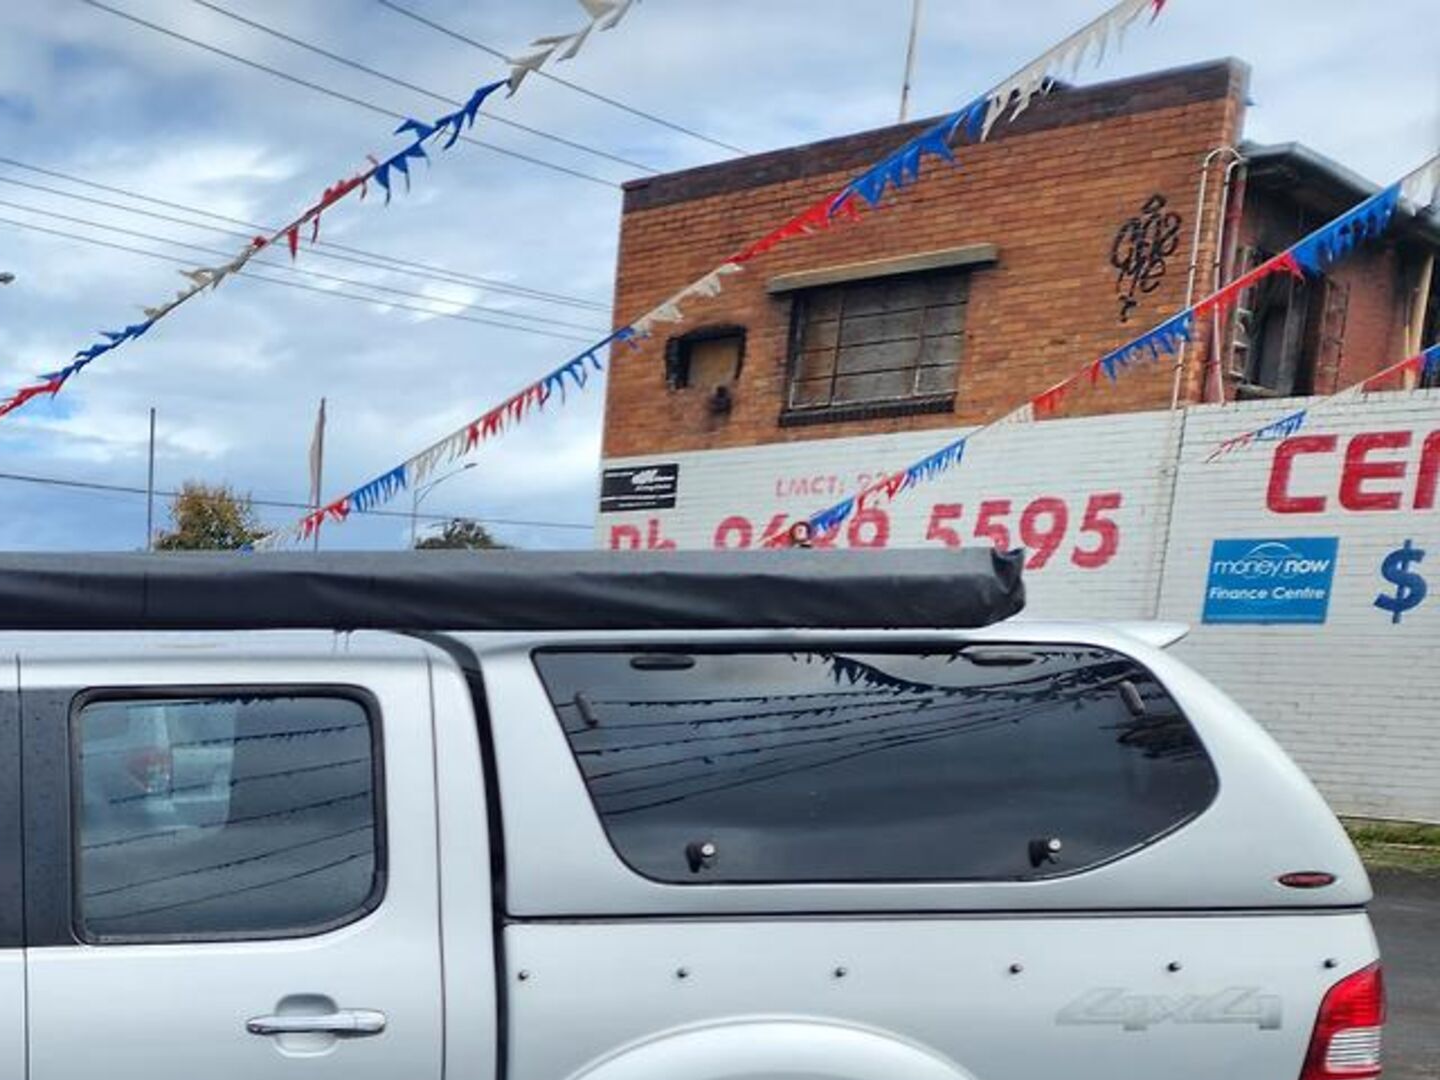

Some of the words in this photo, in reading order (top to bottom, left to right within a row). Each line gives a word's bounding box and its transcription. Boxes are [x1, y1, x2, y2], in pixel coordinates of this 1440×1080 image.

[1212, 559, 1283, 579] money
[1284, 558, 1331, 574] now
[1209, 586, 1269, 600] Finance
[1272, 585, 1327, 600] Centre
